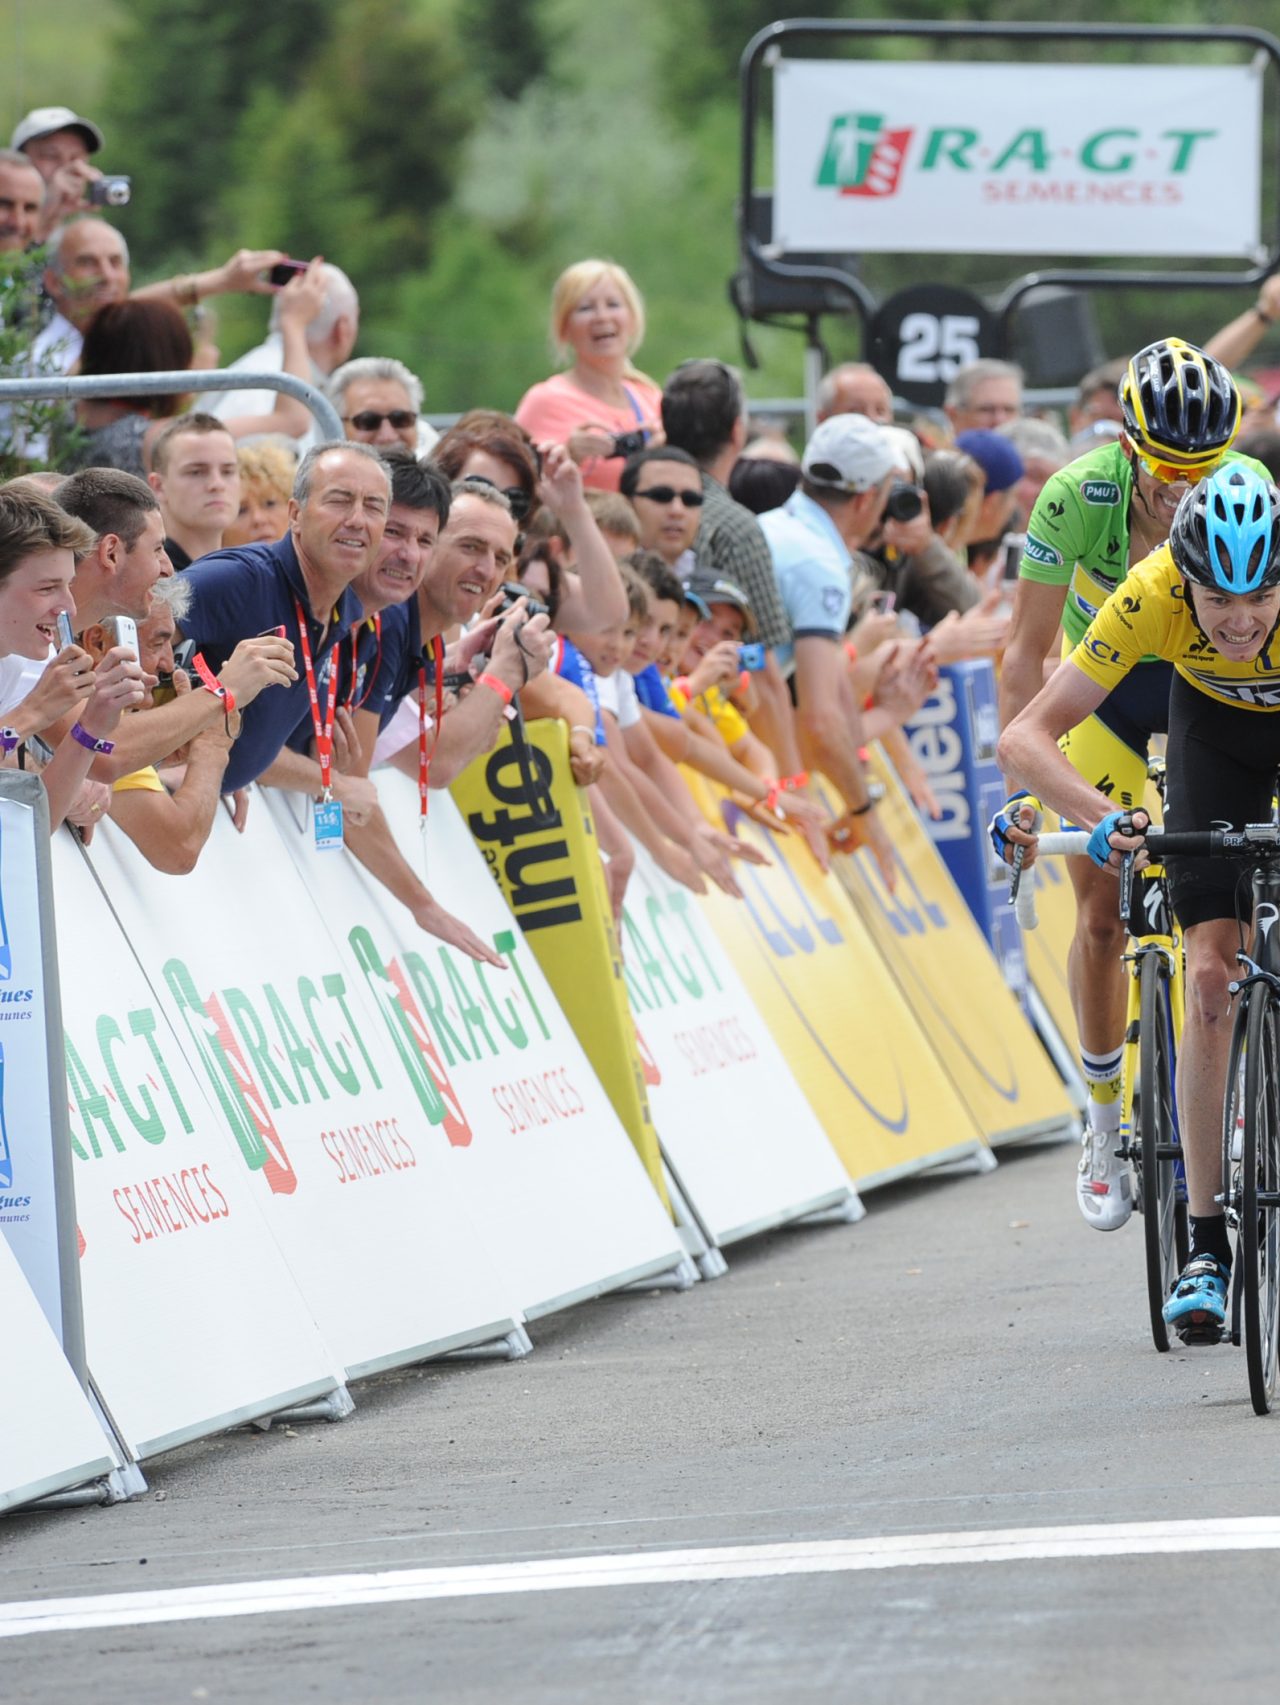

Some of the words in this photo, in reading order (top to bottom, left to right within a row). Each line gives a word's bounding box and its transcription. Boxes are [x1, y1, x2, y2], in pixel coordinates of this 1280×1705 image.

[982, 181, 1184, 206] SEMENCES
[895, 312, 981, 384] 25
[468, 740, 584, 933] info
[492, 1066, 584, 1135] SEMENCES
[320, 1117, 417, 1184] SEMENCES
[112, 1163, 230, 1244] SEMENCES
